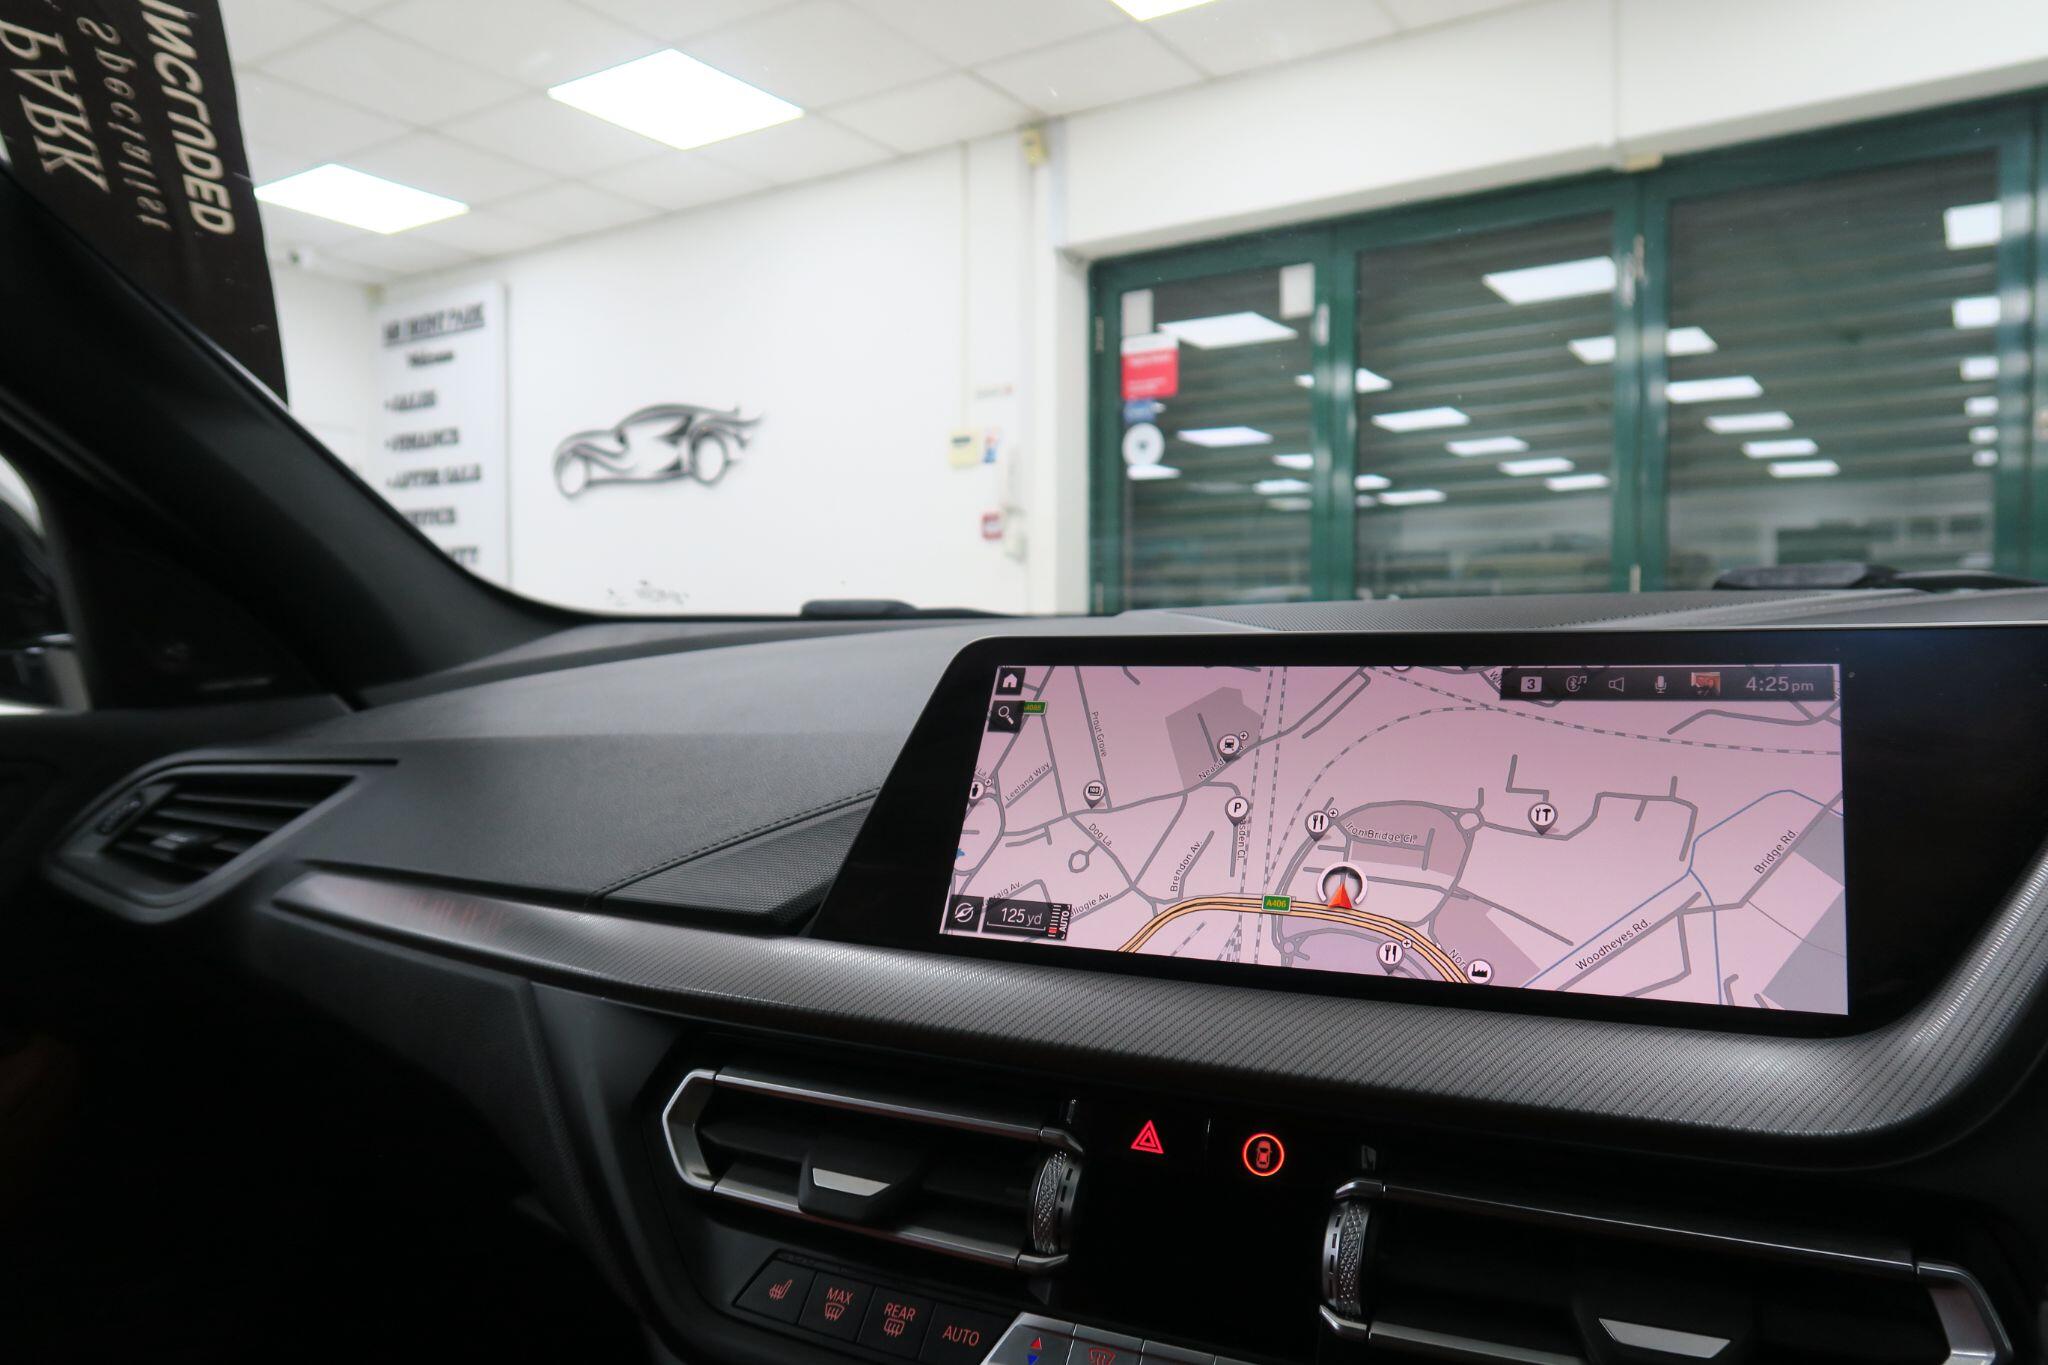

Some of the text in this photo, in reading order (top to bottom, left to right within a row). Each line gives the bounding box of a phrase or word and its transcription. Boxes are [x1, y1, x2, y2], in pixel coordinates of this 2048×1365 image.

[1096, 734, 1107, 757] Grove
[1198, 758, 1224, 780] Neasd
[1004, 762, 1050, 801] Leeland Way
[1088, 823, 1113, 848] Dog La.
[1345, 821, 1367, 837] Iron
[1367, 829, 1401, 843] Bridge
[1753, 844, 1785, 874] Bridge
[1169, 852, 1193, 892] Brendon
[1001, 907, 1043, 927] 125 yd
[1059, 910, 1070, 933] AUTO
[1575, 918, 1652, 971] Woodheyes Rd.
[826, 1287, 854, 1305] MAX
[884, 1302, 916, 1322] REAR
[942, 1325, 980, 1347] AUTO
